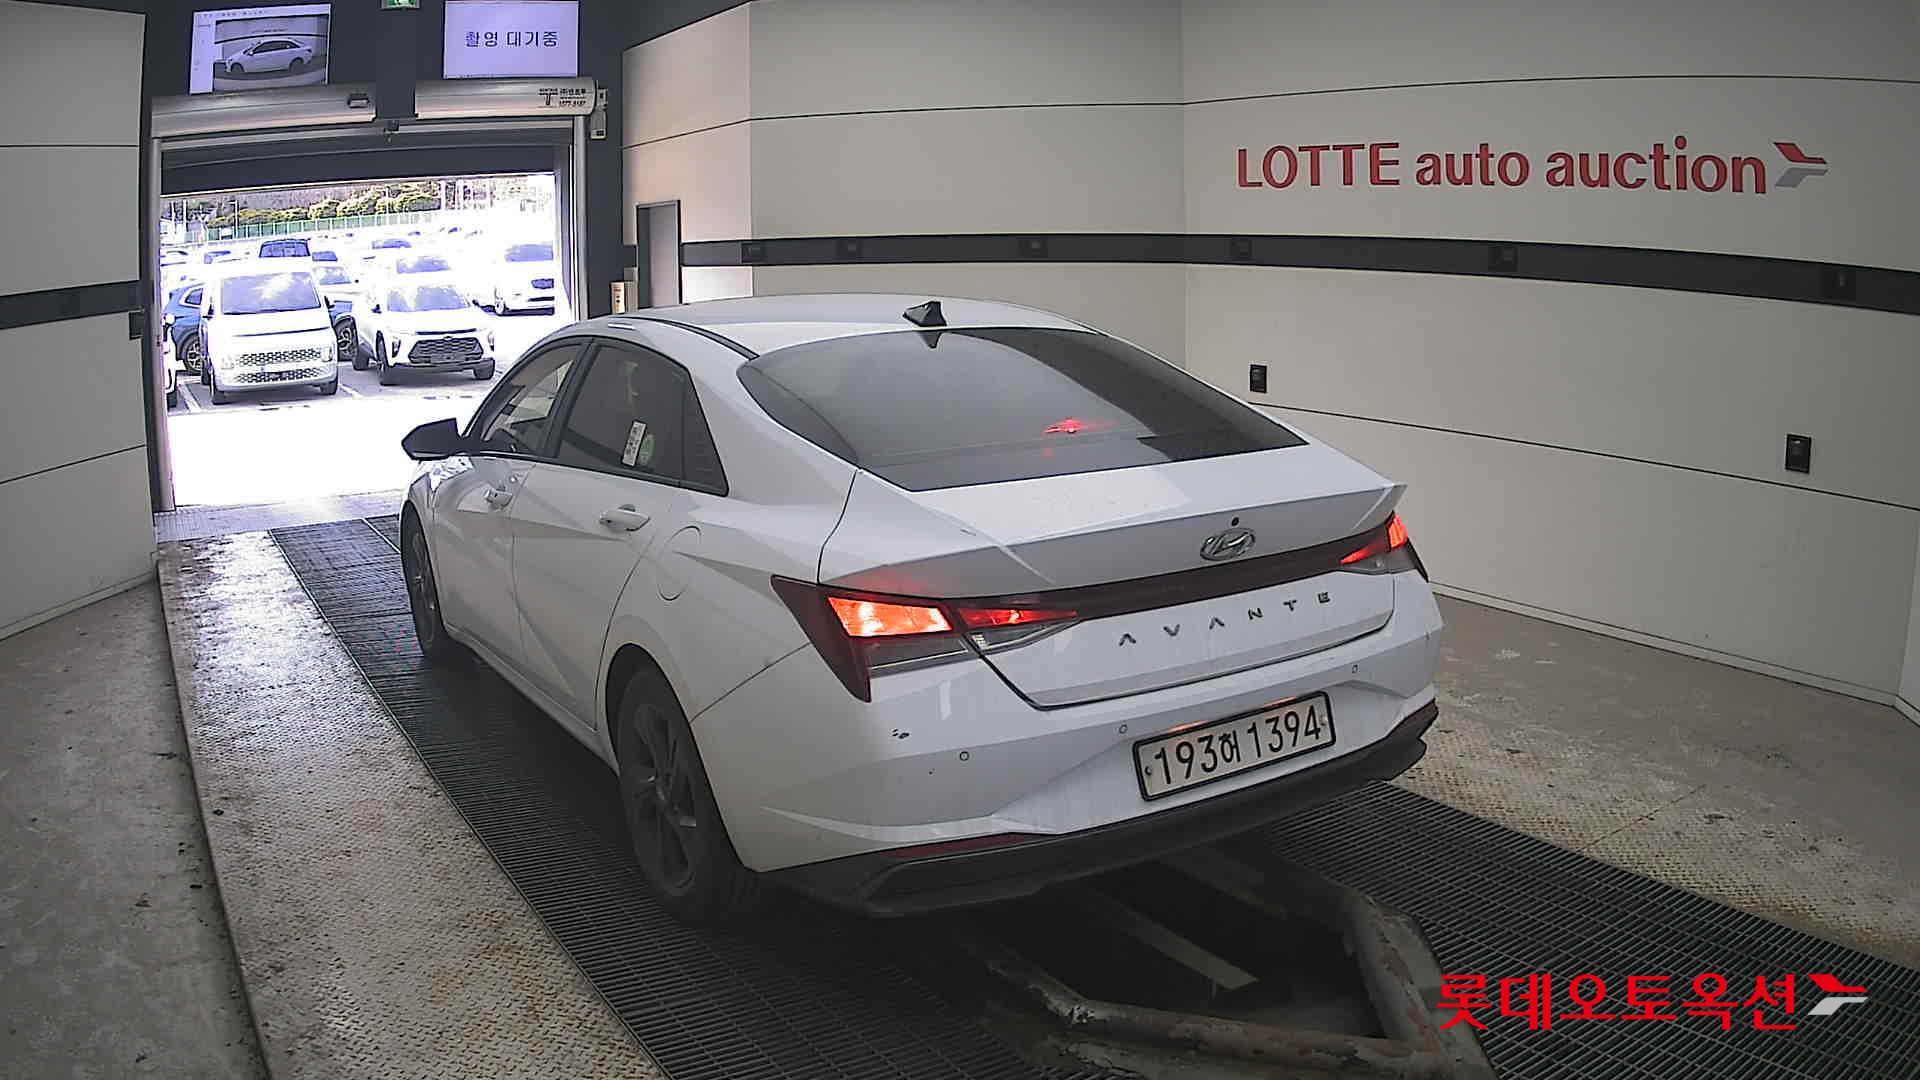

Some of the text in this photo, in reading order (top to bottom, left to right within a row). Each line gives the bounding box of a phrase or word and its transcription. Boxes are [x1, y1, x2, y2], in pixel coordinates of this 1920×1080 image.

[507, 31, 558, 48] 대기중
[1237, 135, 1768, 195] LOTTE auto auction
[1118, 591, 1331, 647] AVANTE
